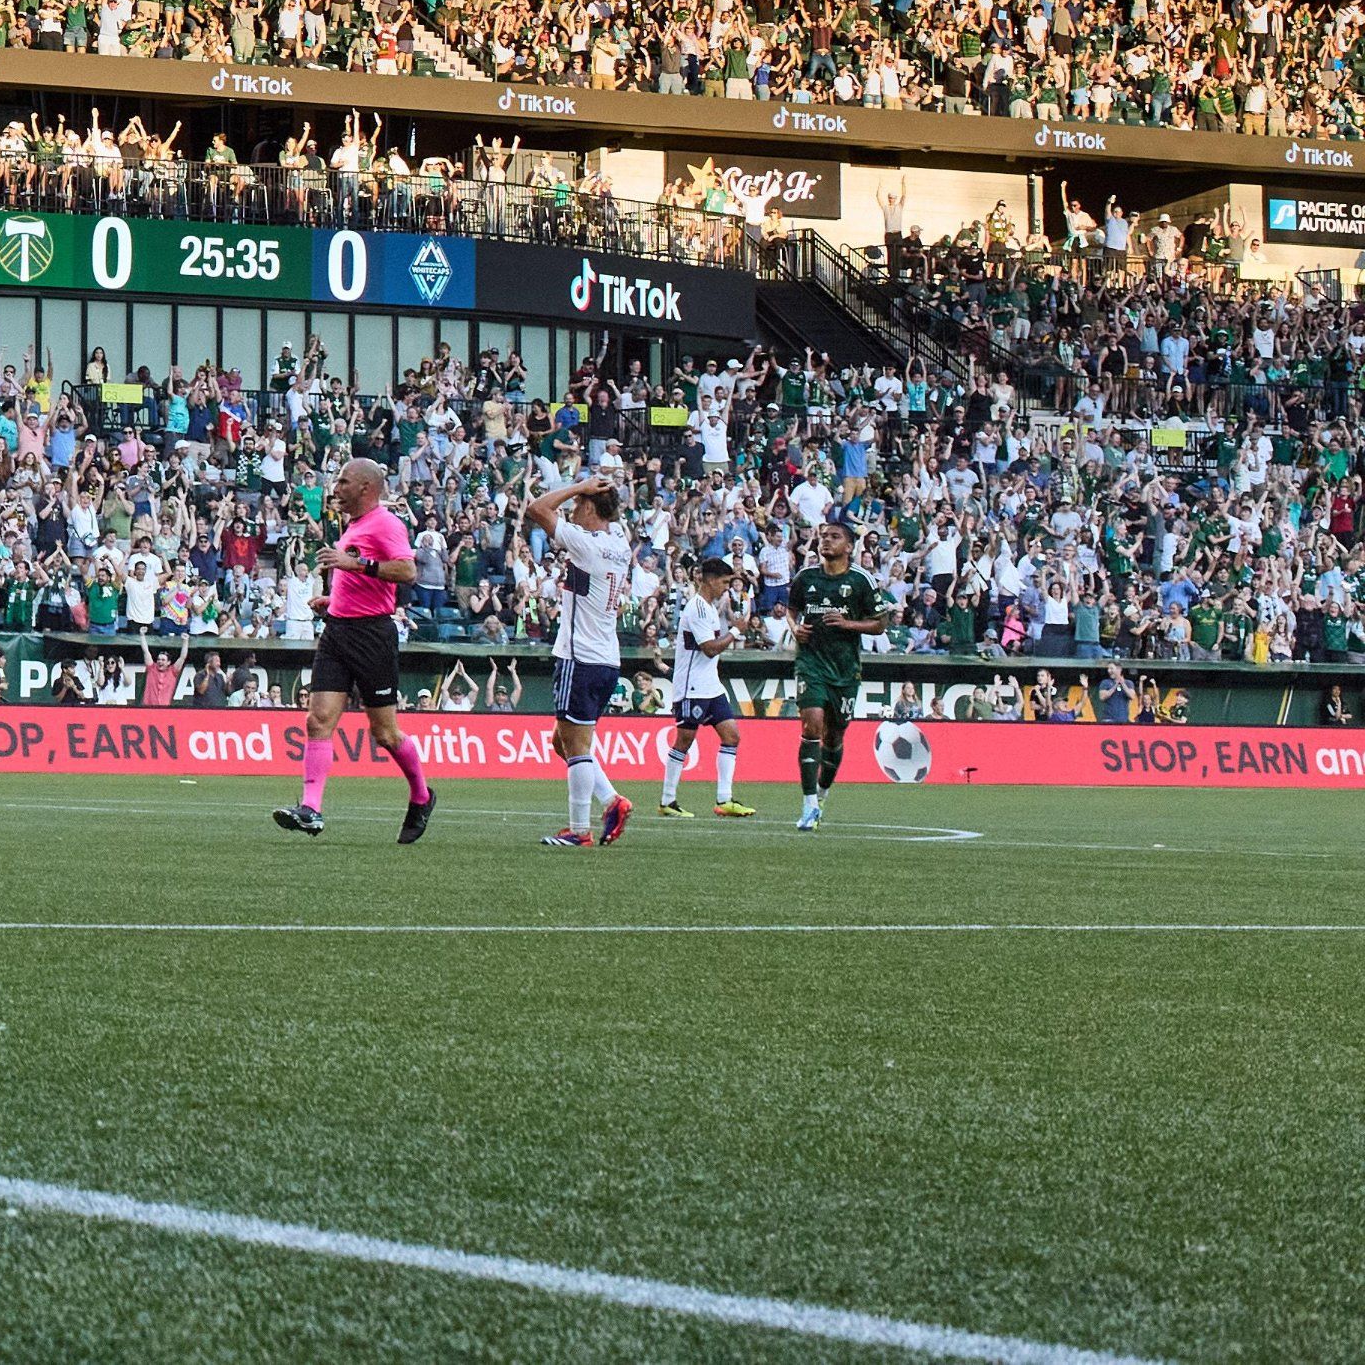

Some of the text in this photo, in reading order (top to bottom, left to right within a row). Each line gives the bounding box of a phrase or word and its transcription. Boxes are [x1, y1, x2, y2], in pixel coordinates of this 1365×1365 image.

[231, 74, 293, 95] TikTok
[517, 93, 577, 115] TikTok
[791, 112, 848, 133] TikTok
[1053, 130, 1106, 151] TikTok
[1302, 147, 1354, 167] TikTok
[783, 171, 815, 203] Jr.
[1298, 200, 1348, 217] PACIFIC
[91, 216, 367, 302] 0 25:35 0
[598, 273, 682, 322] TikTok
[69, 722, 179, 759] EARN
[188, 723, 272, 761] and
[1100, 738, 1208, 778] SHOP,
[1215, 741, 1308, 775] EARN
